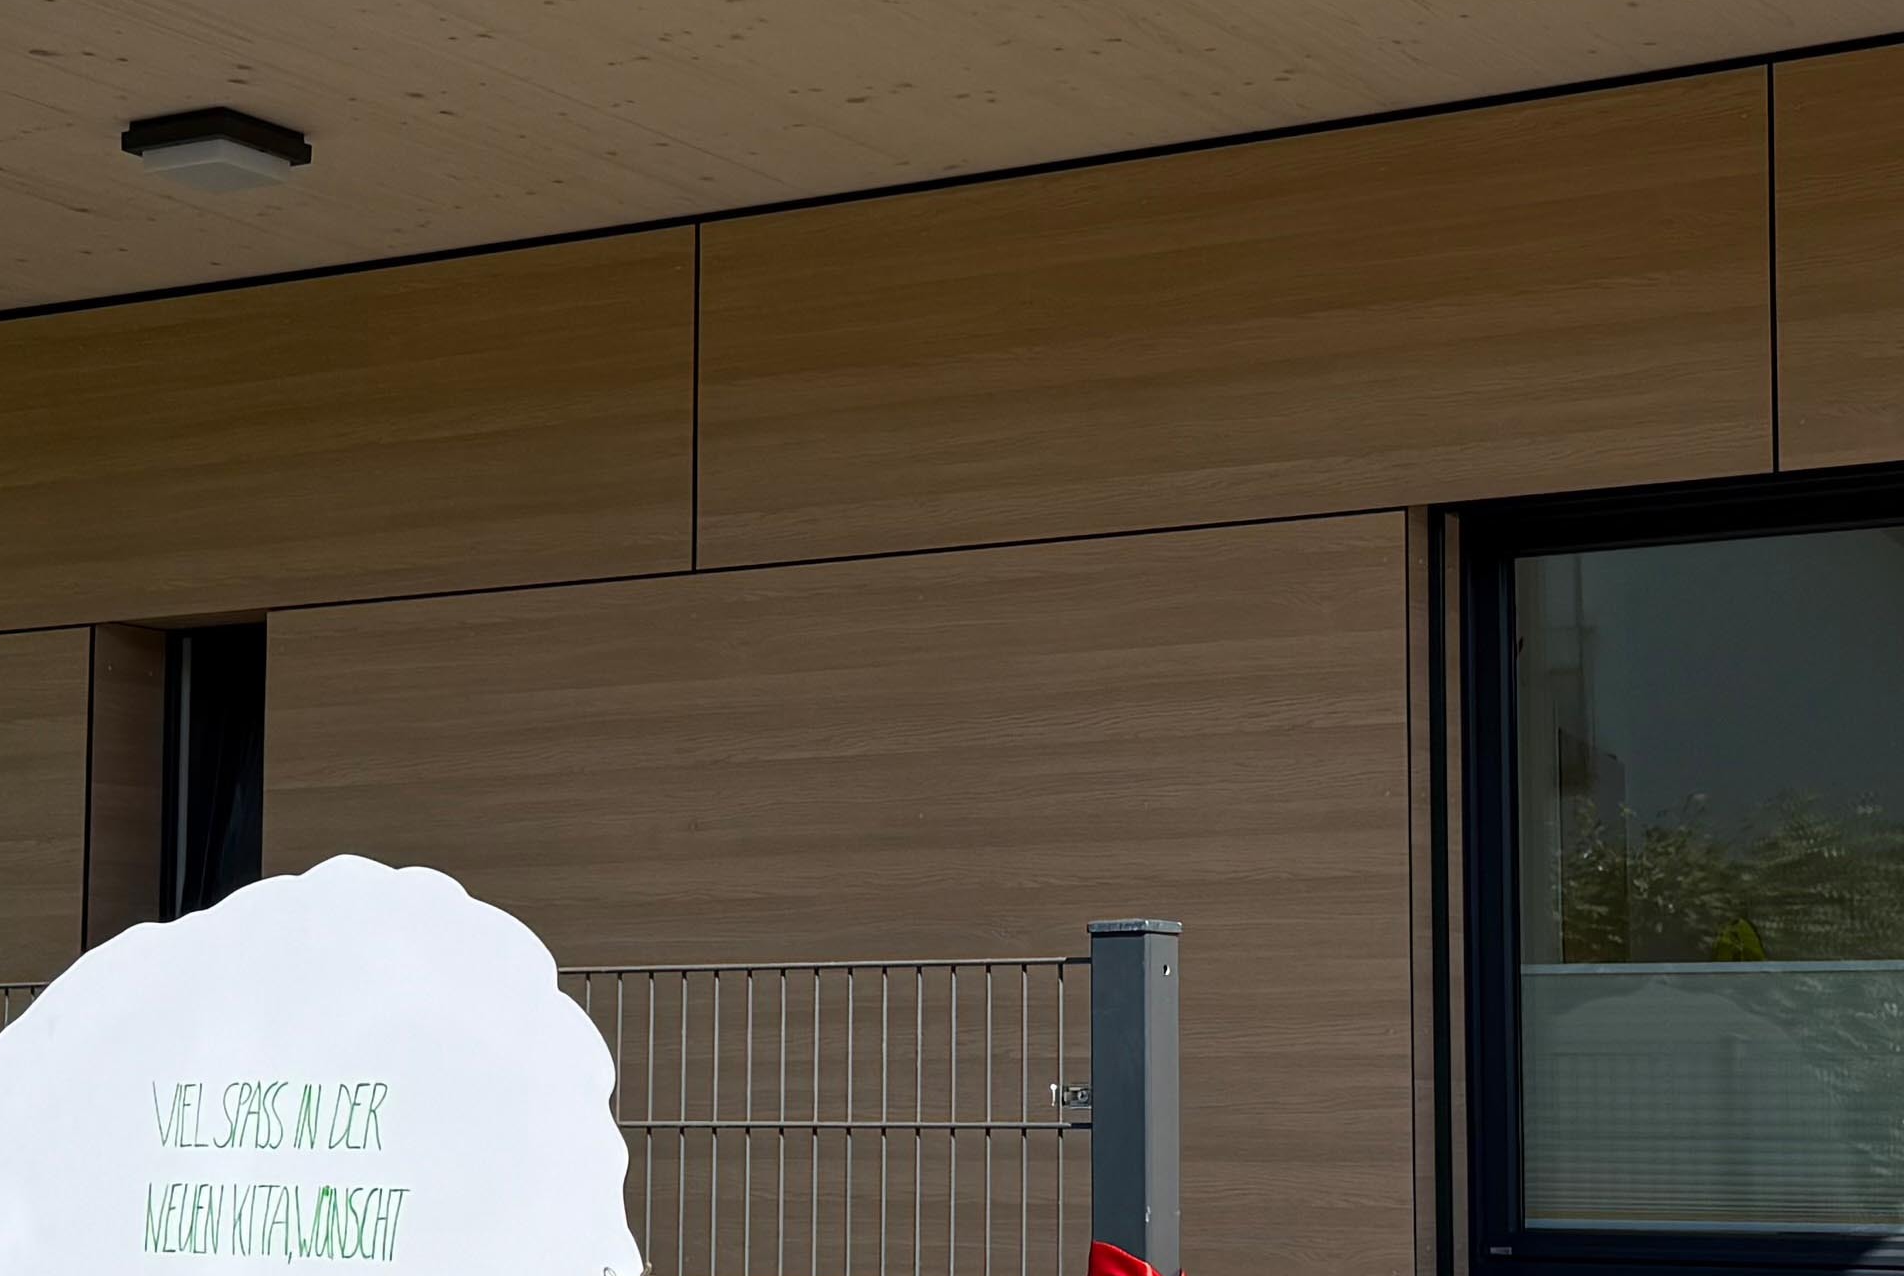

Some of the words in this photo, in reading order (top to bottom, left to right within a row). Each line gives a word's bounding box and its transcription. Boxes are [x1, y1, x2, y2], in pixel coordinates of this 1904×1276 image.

[152, 1080, 209, 1148] VIEL
[212, 1080, 289, 1150] SPASS
[293, 1083, 322, 1150] IN
[328, 1082, 389, 1151] DER
[144, 1182, 224, 1255] NEUEN
